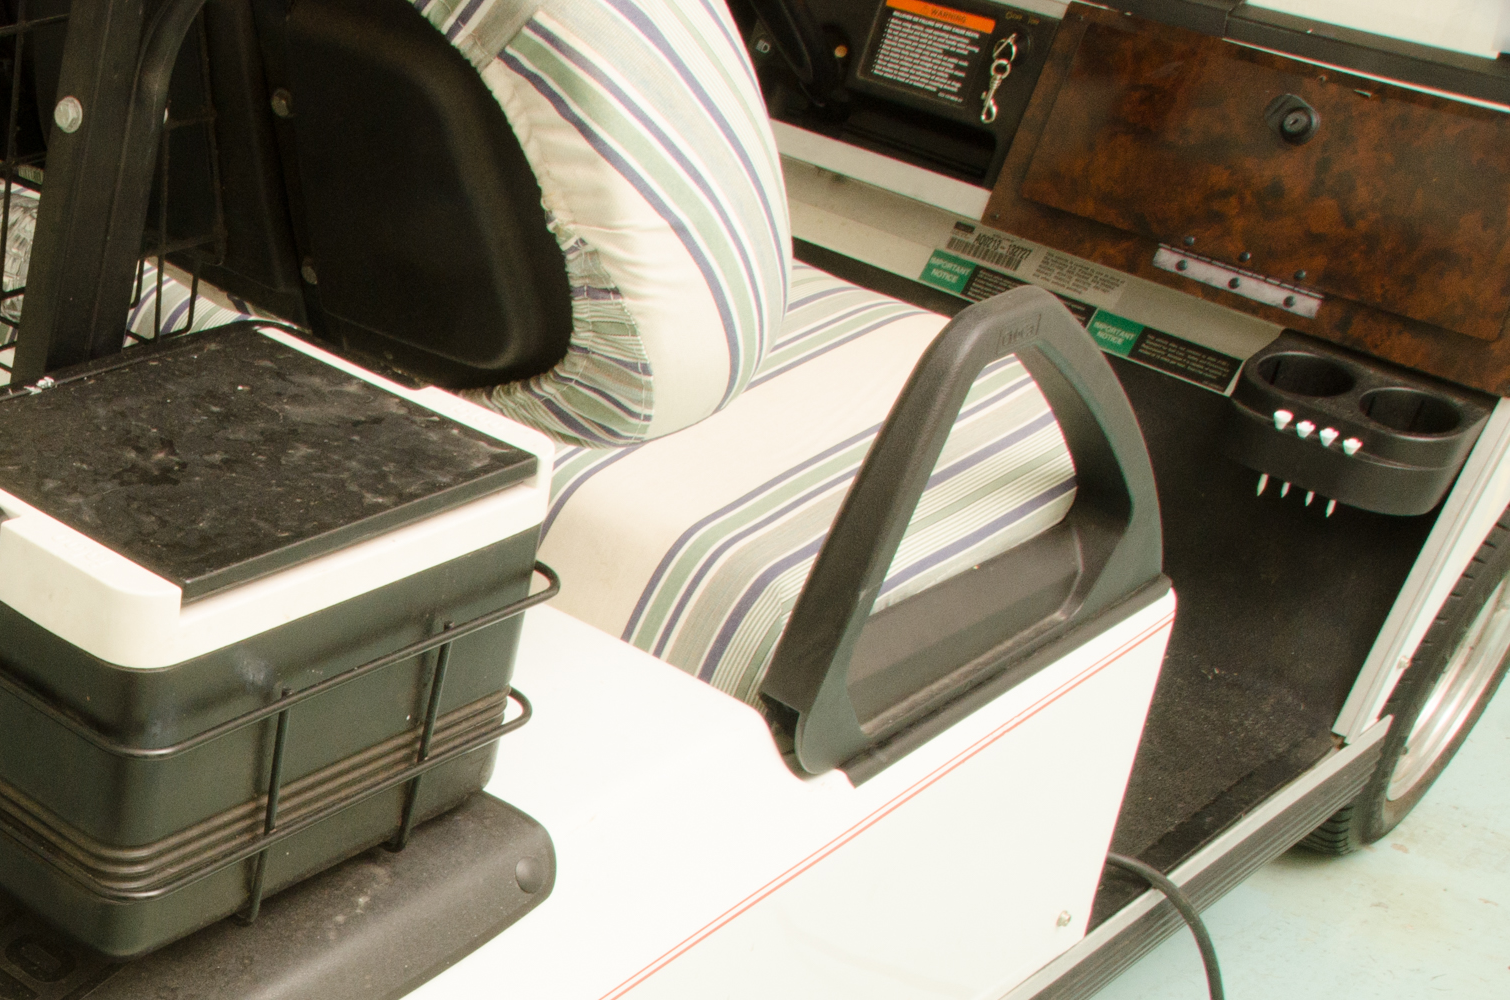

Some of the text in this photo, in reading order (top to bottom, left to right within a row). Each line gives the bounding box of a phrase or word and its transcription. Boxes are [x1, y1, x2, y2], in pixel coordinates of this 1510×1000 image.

[931, 9, 967, 23] WARNING
[930, 256, 973, 277] IMPORTANT
[930, 268, 959, 284] NOTICE
[1093, 321, 1136, 340] IMPORTANT
[1096, 331, 1124, 345] NOTICE
